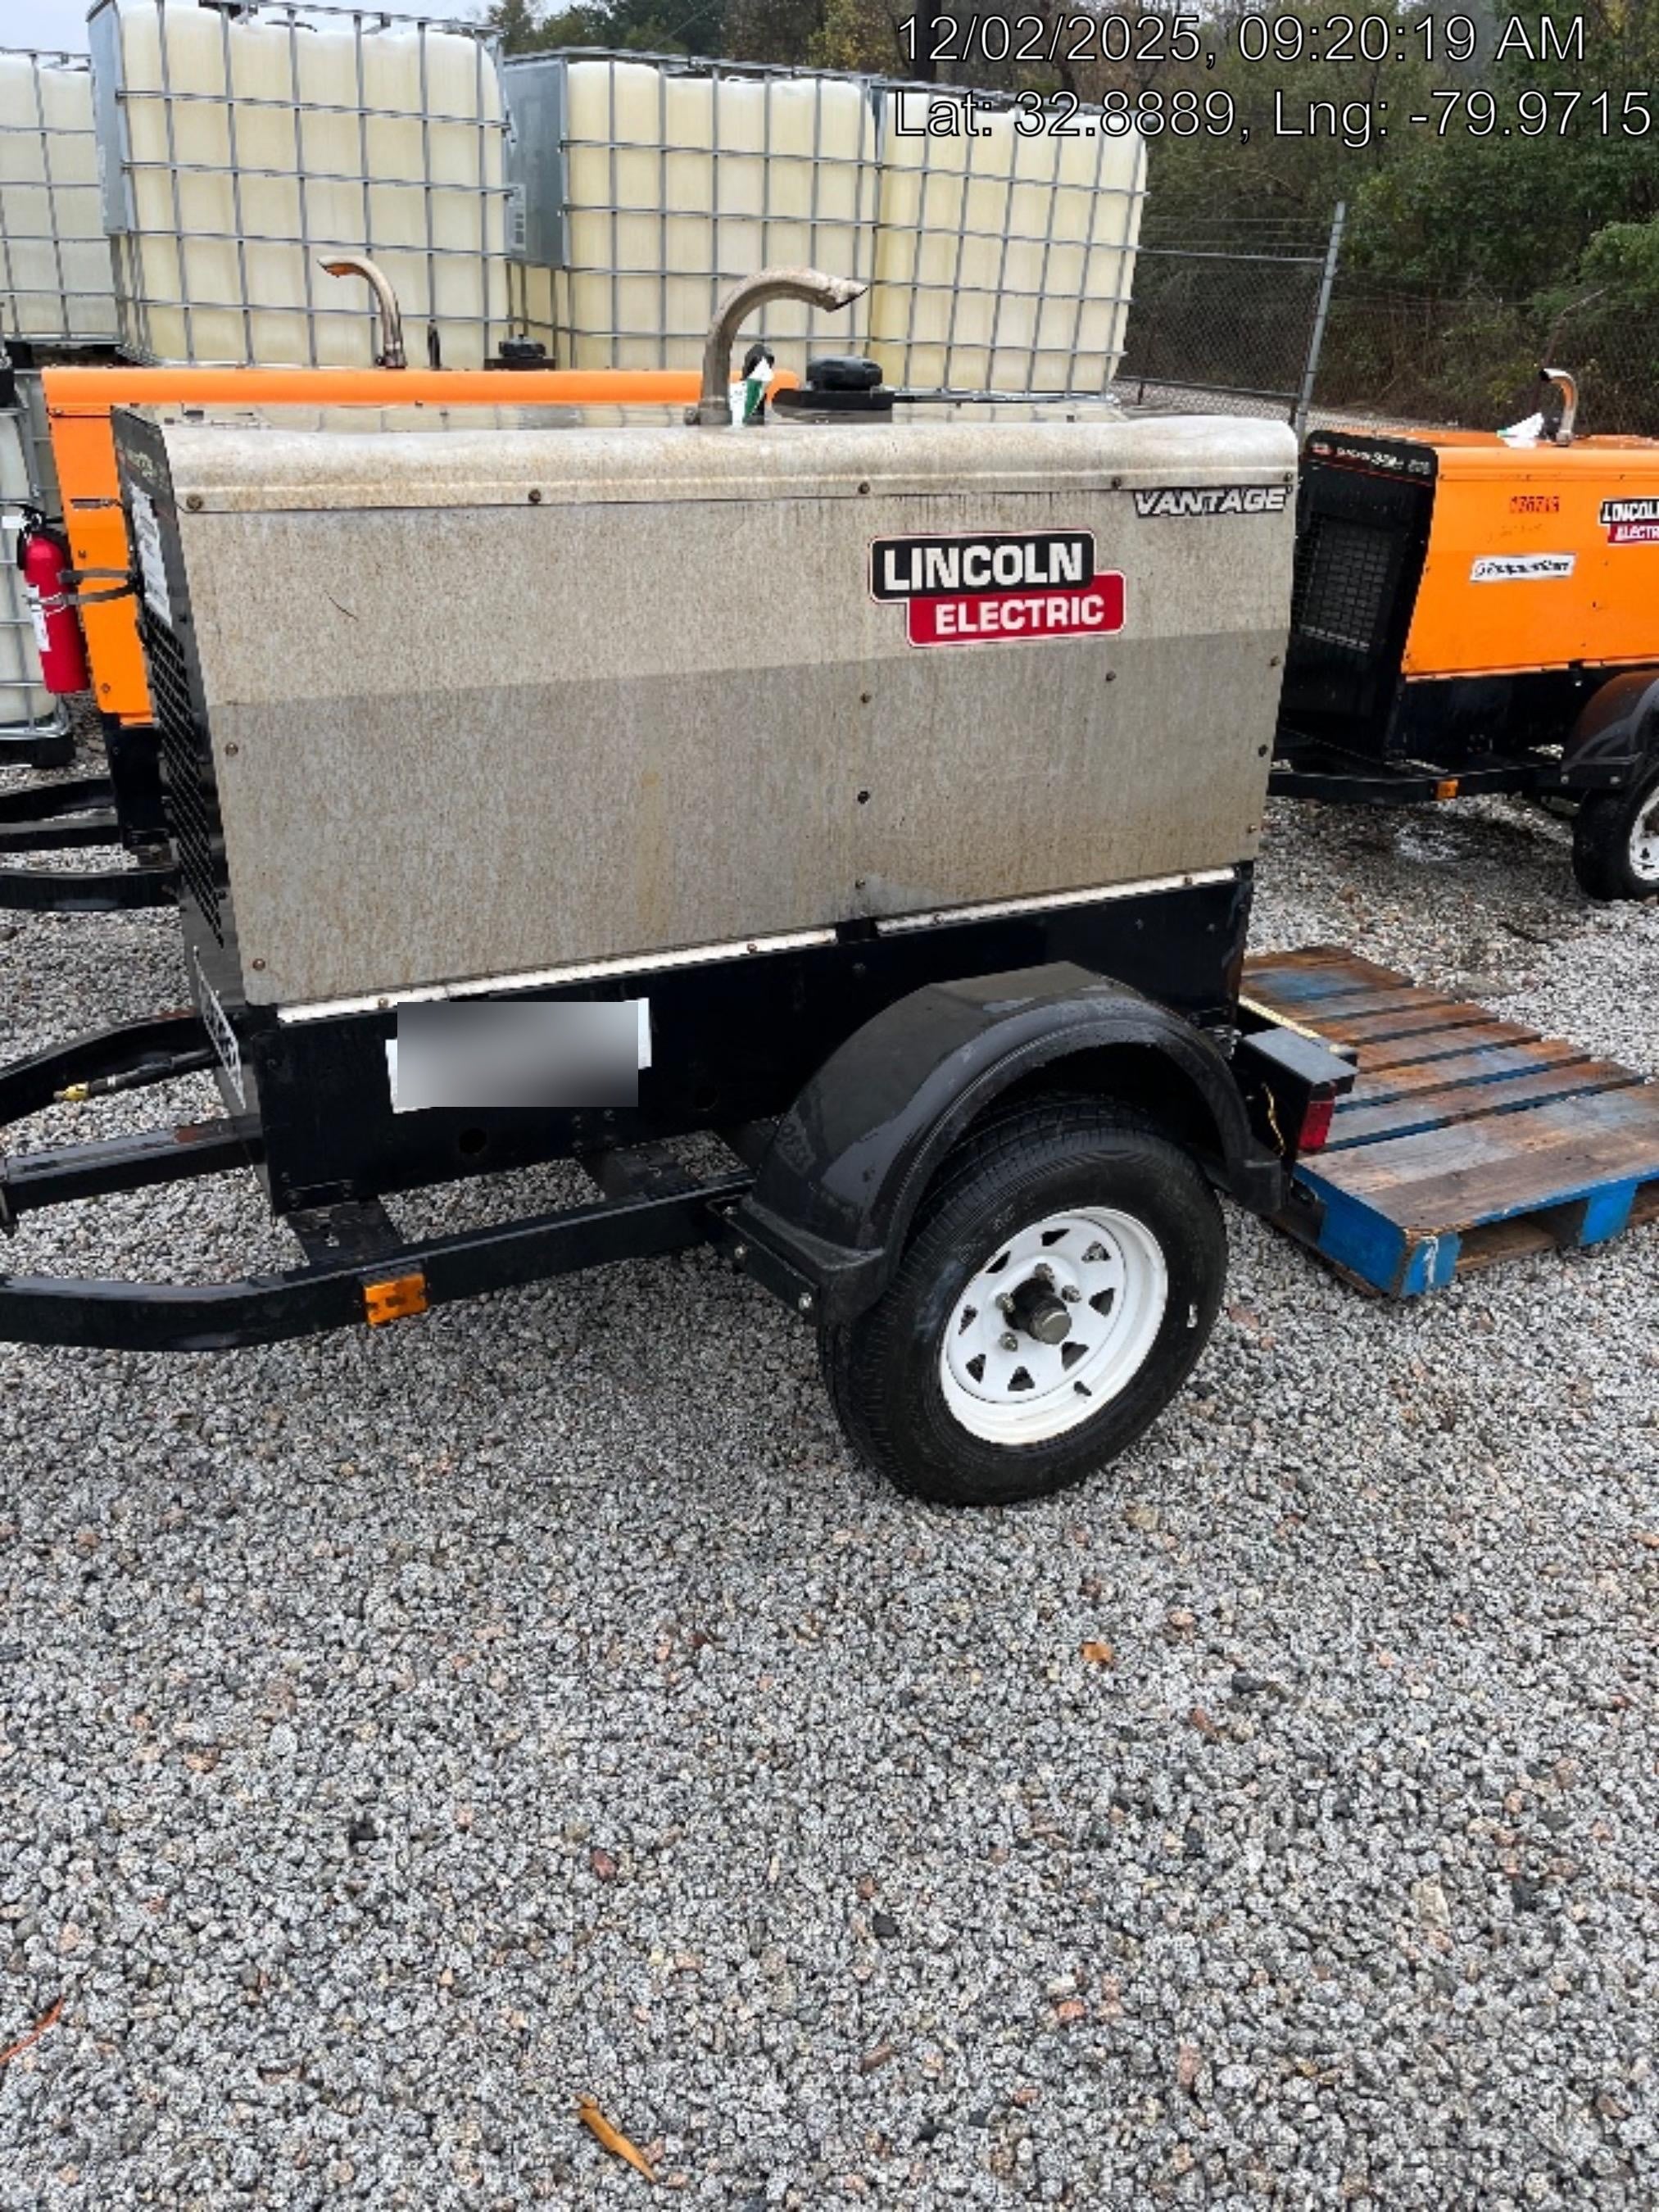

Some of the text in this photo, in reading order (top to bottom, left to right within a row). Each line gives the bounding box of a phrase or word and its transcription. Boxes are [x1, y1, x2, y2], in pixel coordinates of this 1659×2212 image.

[1134, 487, 1288, 516] VANTAGE
[883, 542, 1083, 591] LINCOLN
[935, 595, 1104, 635] ELECTRIC
